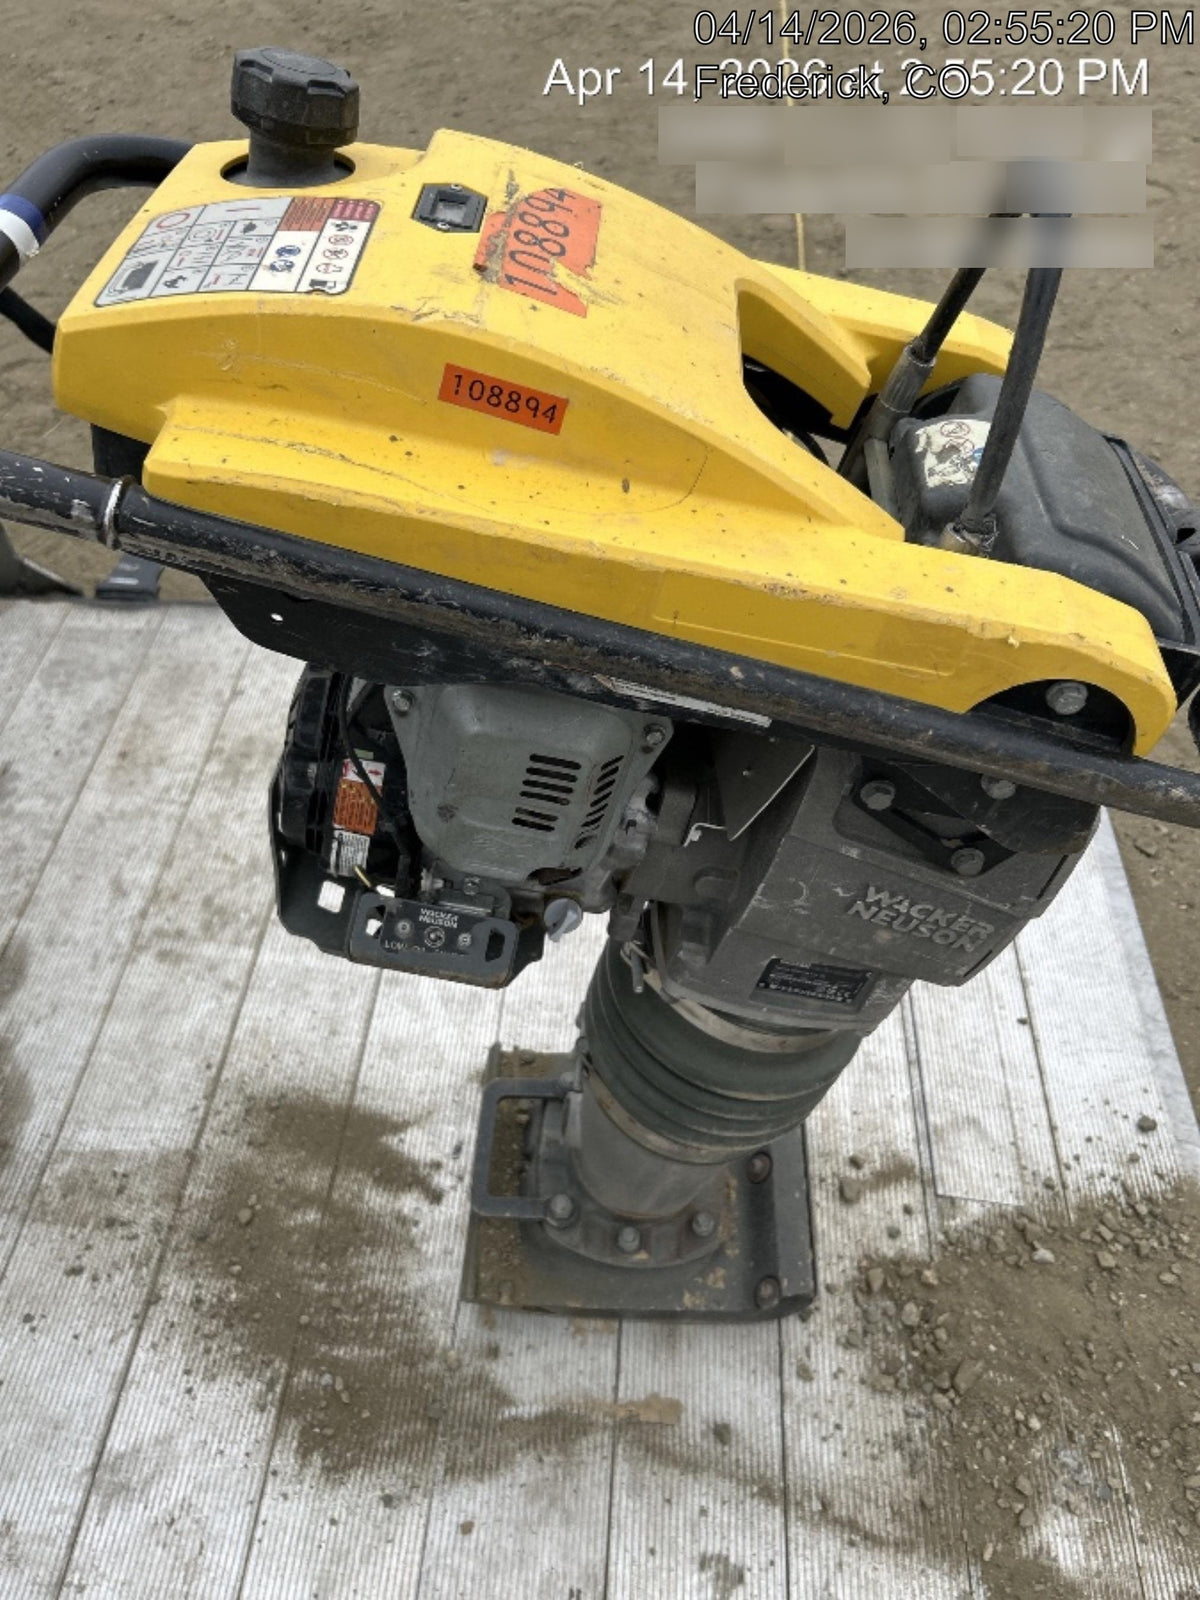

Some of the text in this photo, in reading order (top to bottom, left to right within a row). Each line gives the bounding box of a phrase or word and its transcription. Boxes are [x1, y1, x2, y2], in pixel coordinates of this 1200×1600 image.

[503, 187, 577, 296] 108894
[453, 374, 558, 424] 108894
[848, 900, 984, 952] NEUSON
[865, 885, 995, 942] WACKER
